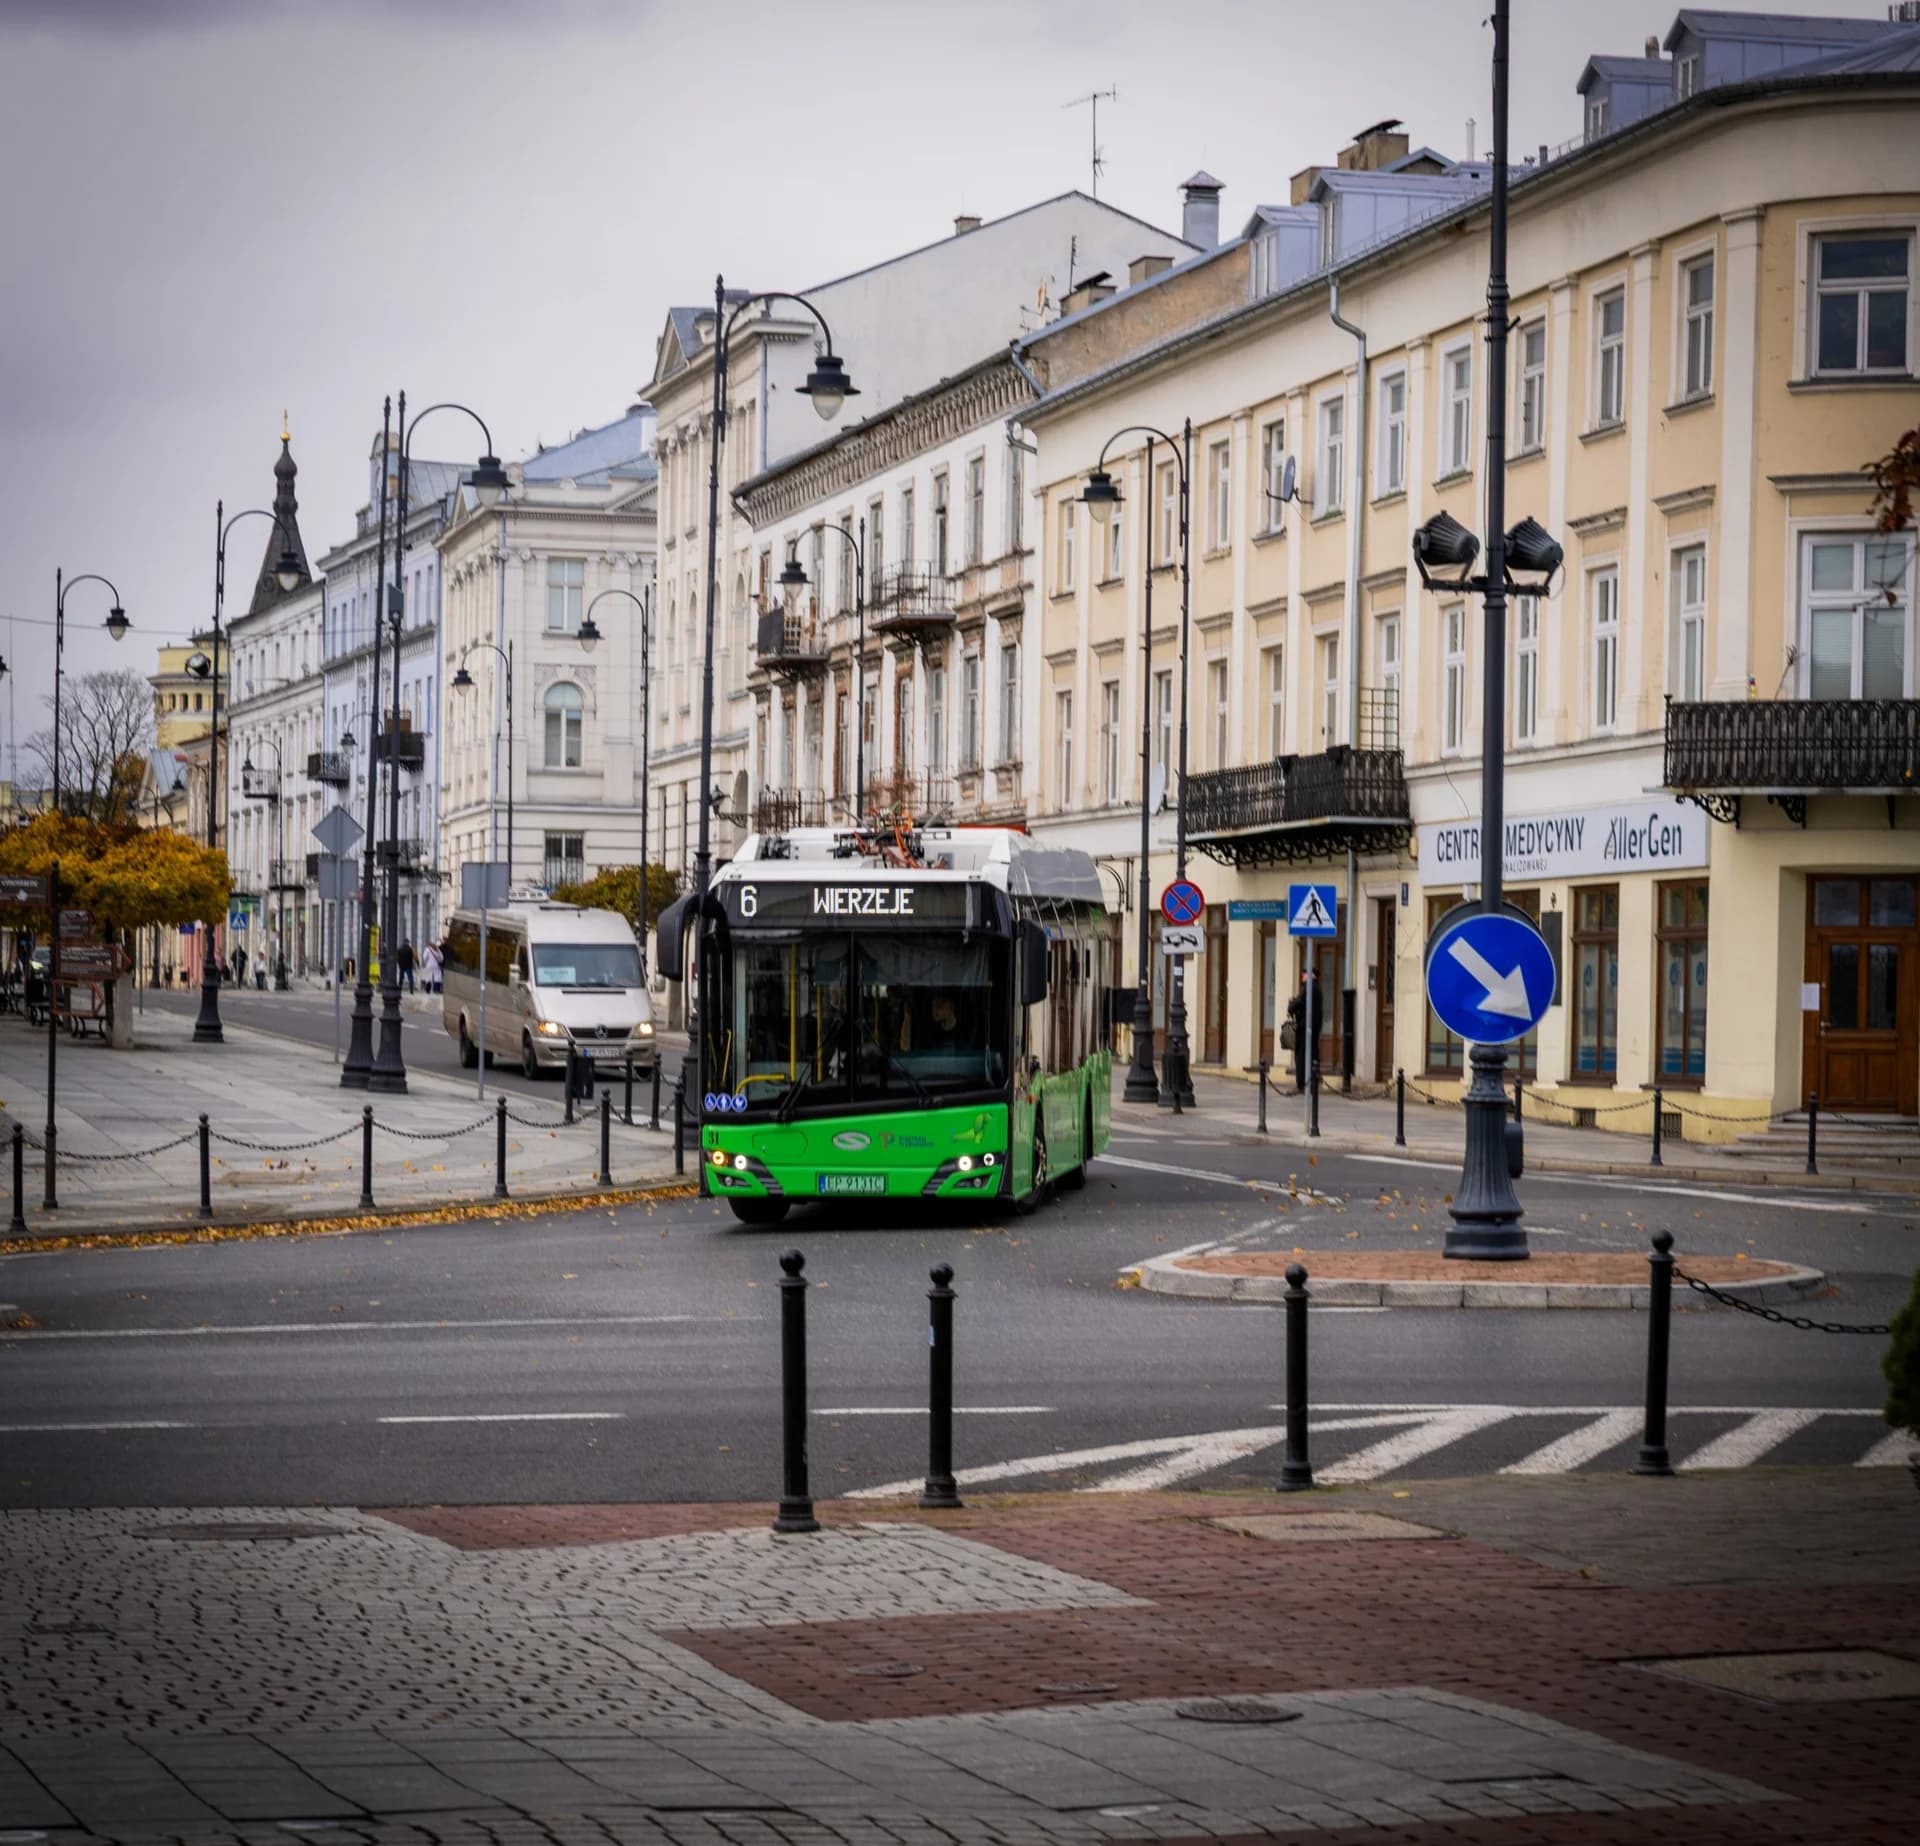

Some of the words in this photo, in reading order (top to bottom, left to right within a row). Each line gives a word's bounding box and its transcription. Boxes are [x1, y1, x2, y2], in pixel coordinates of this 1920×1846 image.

[1437, 828, 1482, 862] CENTR
[1505, 817, 1585, 857] MEDYCYNY
[1603, 813, 1682, 860] AllerGen
[1503, 858, 1548, 873] NALIZOWANEJ
[740, 885, 757, 917] 6
[813, 888, 914, 914] WIERZEJE
